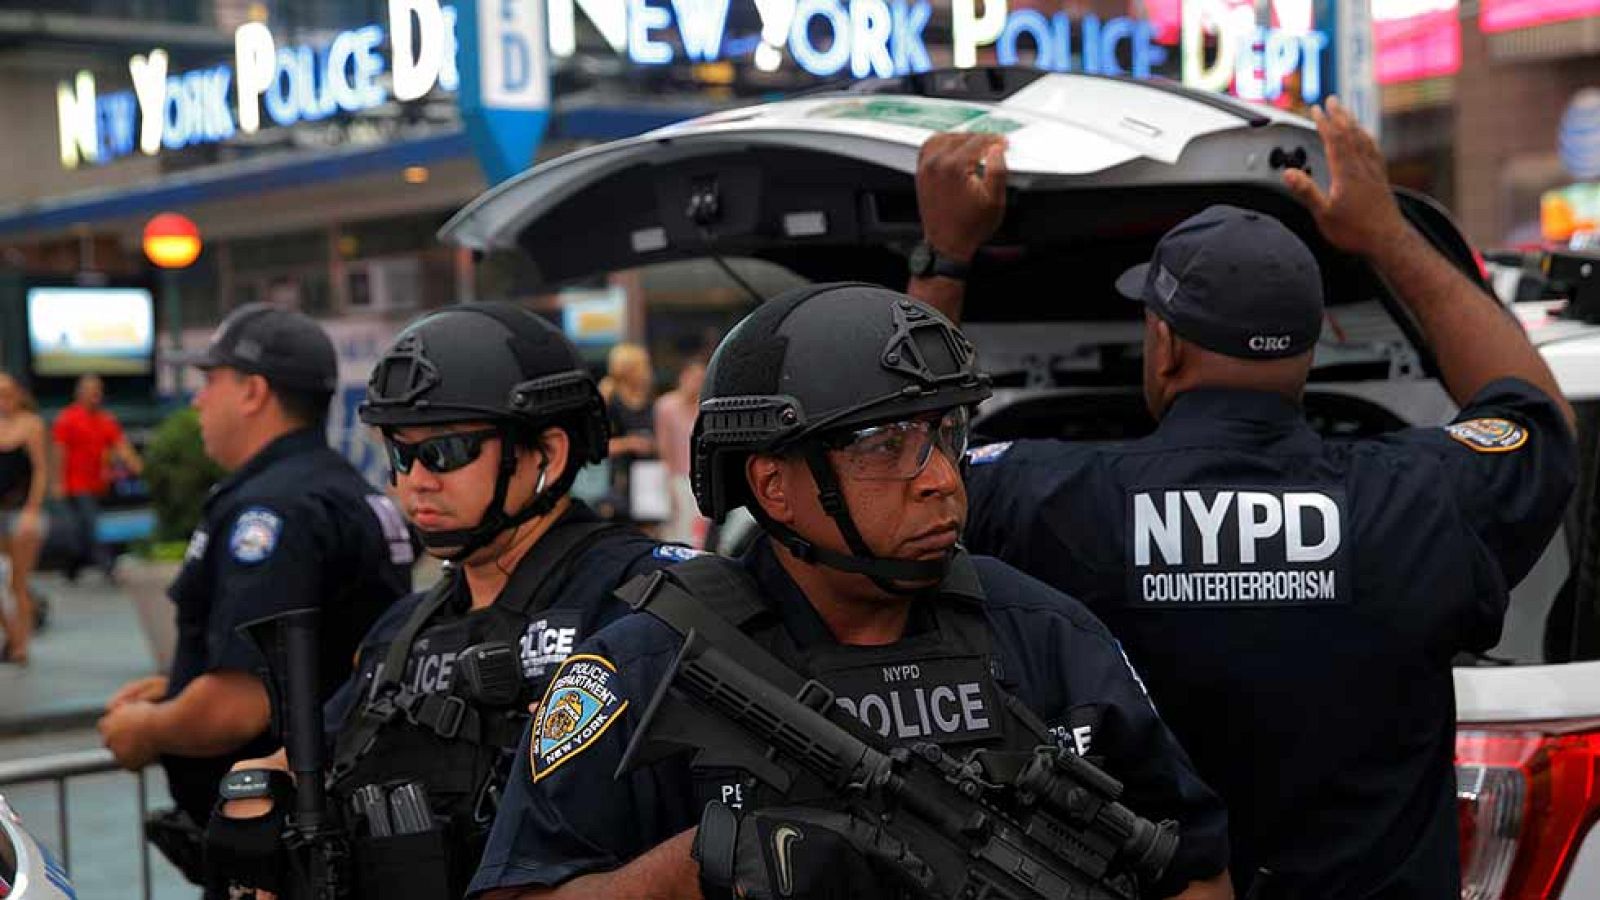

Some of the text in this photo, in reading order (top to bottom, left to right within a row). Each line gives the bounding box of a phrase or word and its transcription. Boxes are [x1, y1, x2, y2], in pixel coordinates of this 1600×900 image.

[953, 0, 1168, 78] POLICE
[129, 48, 236, 155] YORK
[234, 22, 387, 133] POLICE
[1248, 335, 1291, 351] CRC
[1133, 491, 1342, 566] NYPD
[1142, 569, 1336, 603] COUNTERTERRORISM
[569, 662, 610, 685] POLICE
[882, 664, 921, 682] NYPD
[552, 674, 618, 707] DEPARTMENT
[546, 742, 572, 765] NEW
[573, 713, 608, 744] YORK
